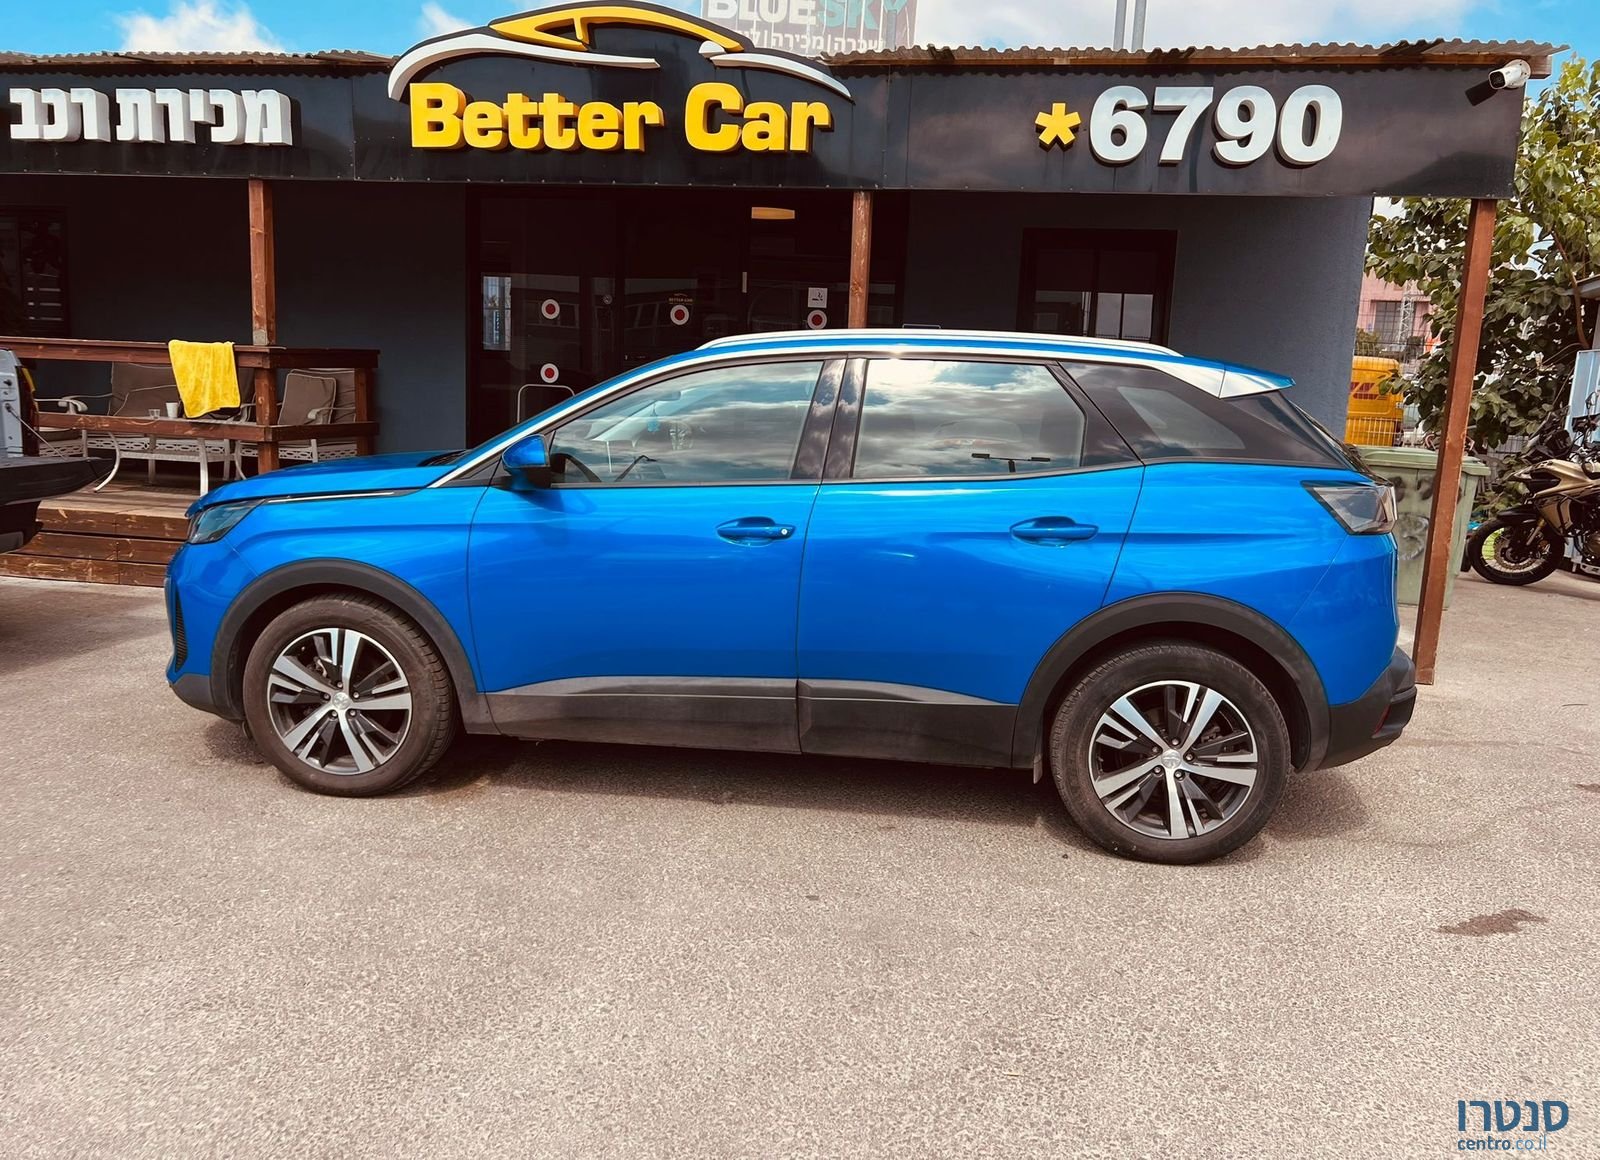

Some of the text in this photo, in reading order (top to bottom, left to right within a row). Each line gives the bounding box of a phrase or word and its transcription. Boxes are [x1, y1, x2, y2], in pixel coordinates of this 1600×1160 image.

[9, 88, 292, 145] מכירת רכב
[410, 82, 833, 154] Better Car
